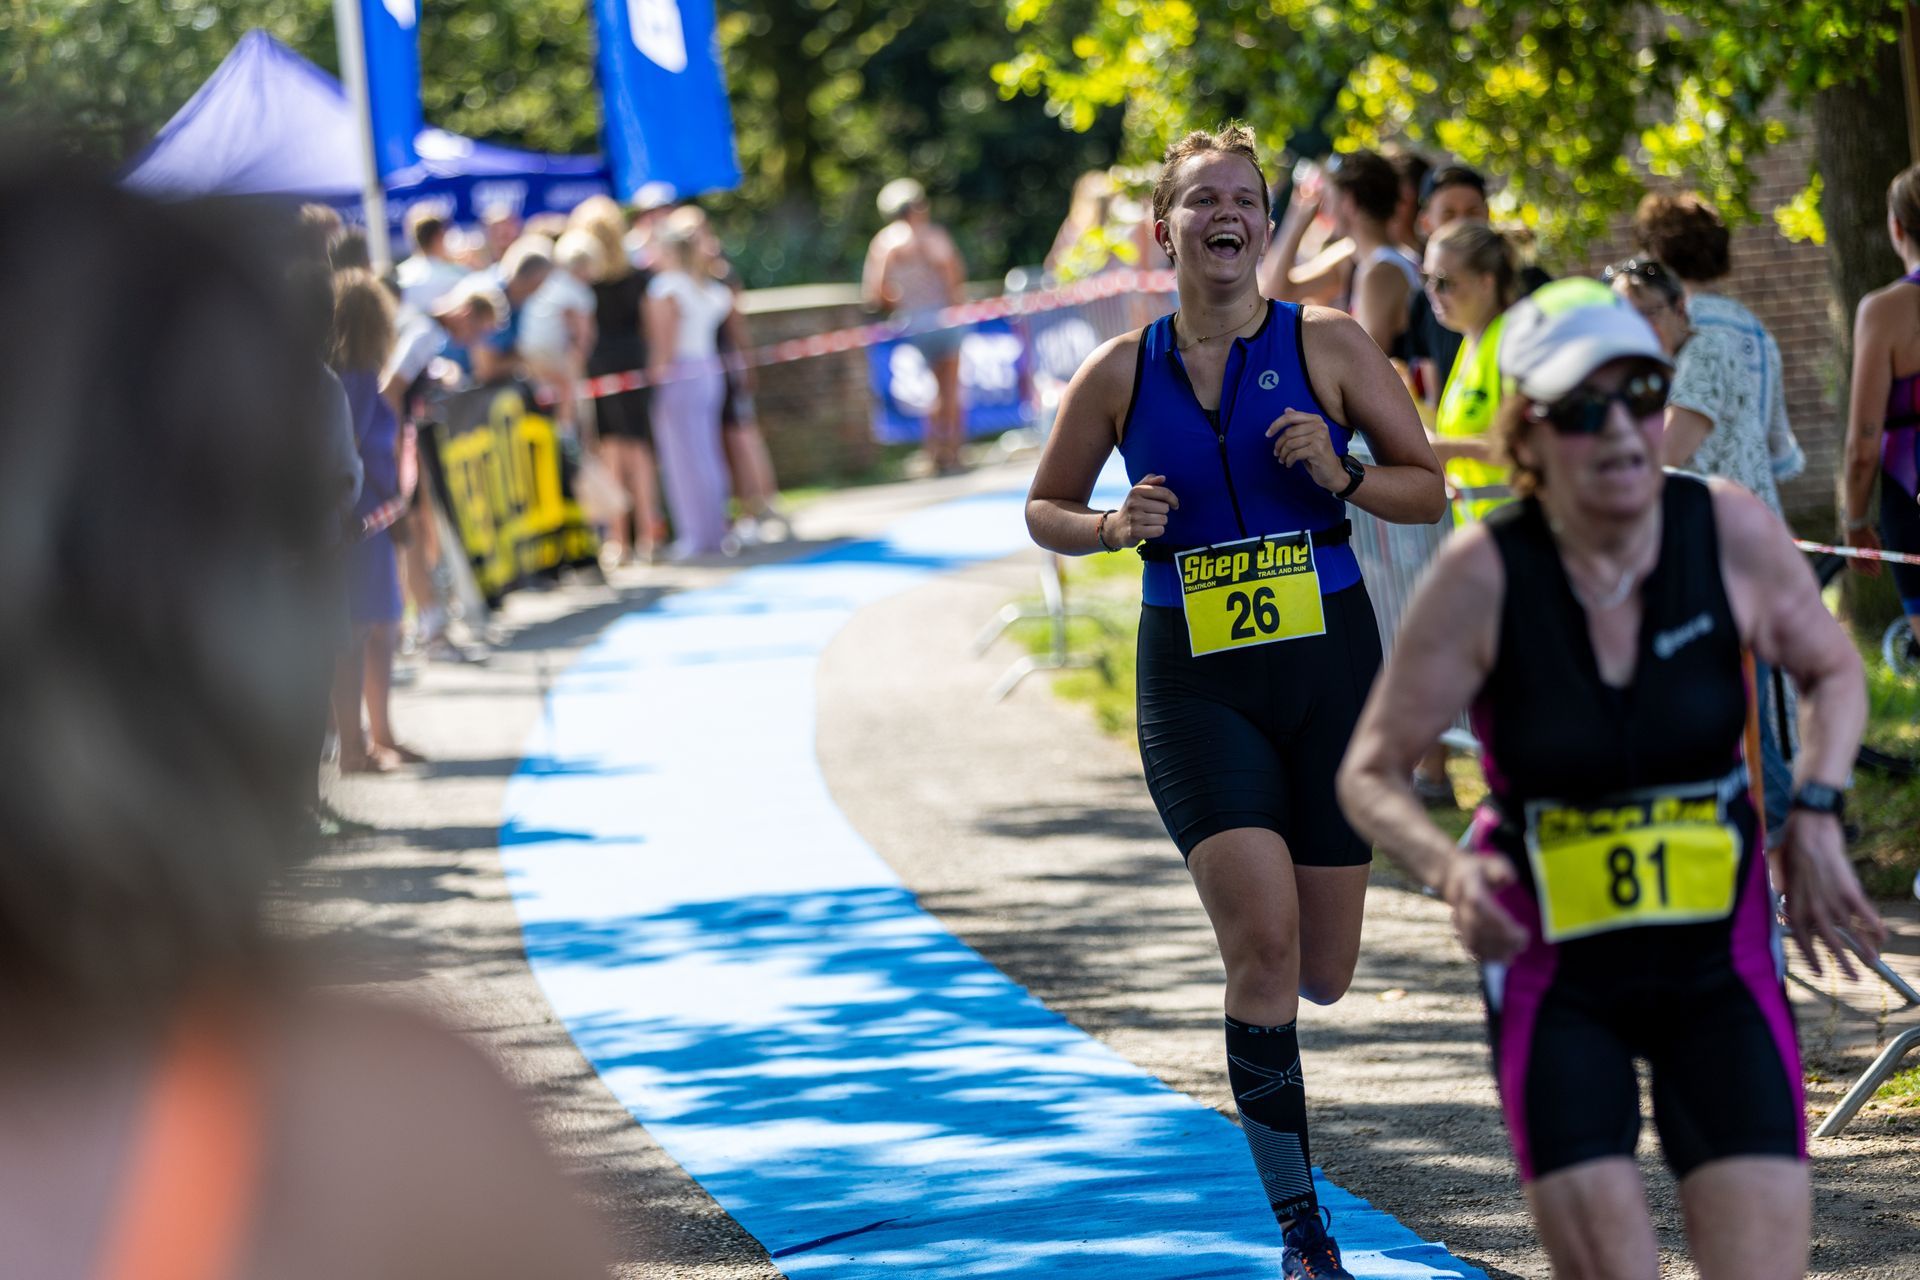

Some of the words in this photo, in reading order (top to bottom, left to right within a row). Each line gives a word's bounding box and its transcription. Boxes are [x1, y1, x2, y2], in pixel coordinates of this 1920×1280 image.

[1184, 552, 1250, 584] Step
[1256, 541, 1308, 569] One
[1257, 569, 1277, 578] TRAIL
[1278, 567, 1293, 575] AND
[1293, 565, 1307, 573] RUN
[1184, 580, 1217, 593] TRIATHLON
[1226, 586, 1280, 641] 26
[1607, 838, 1668, 910] 81
